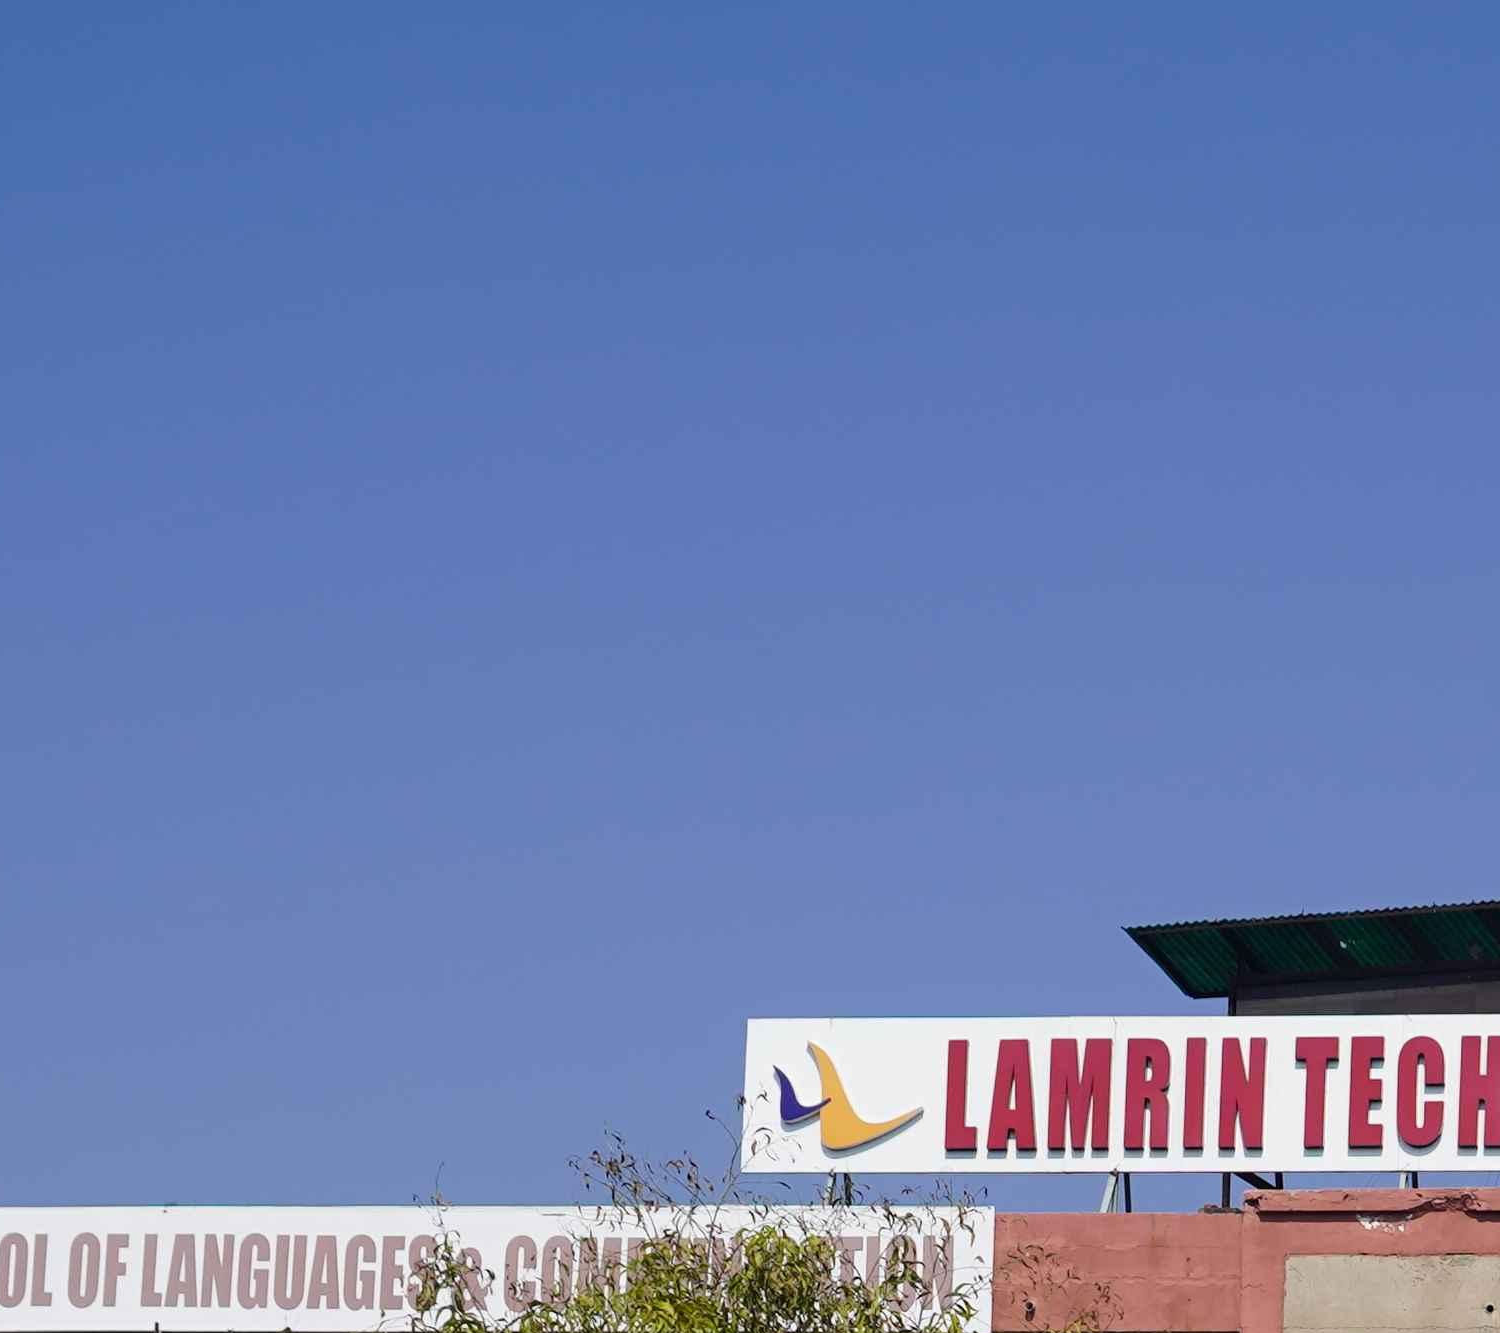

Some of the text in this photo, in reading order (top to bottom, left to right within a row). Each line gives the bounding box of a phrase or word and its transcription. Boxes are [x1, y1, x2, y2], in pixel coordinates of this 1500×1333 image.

[944, 1038, 1268, 1150] LAMRIN
[67, 1231, 130, 1309] OF
[139, 1232, 438, 1311] LANGUAGES
